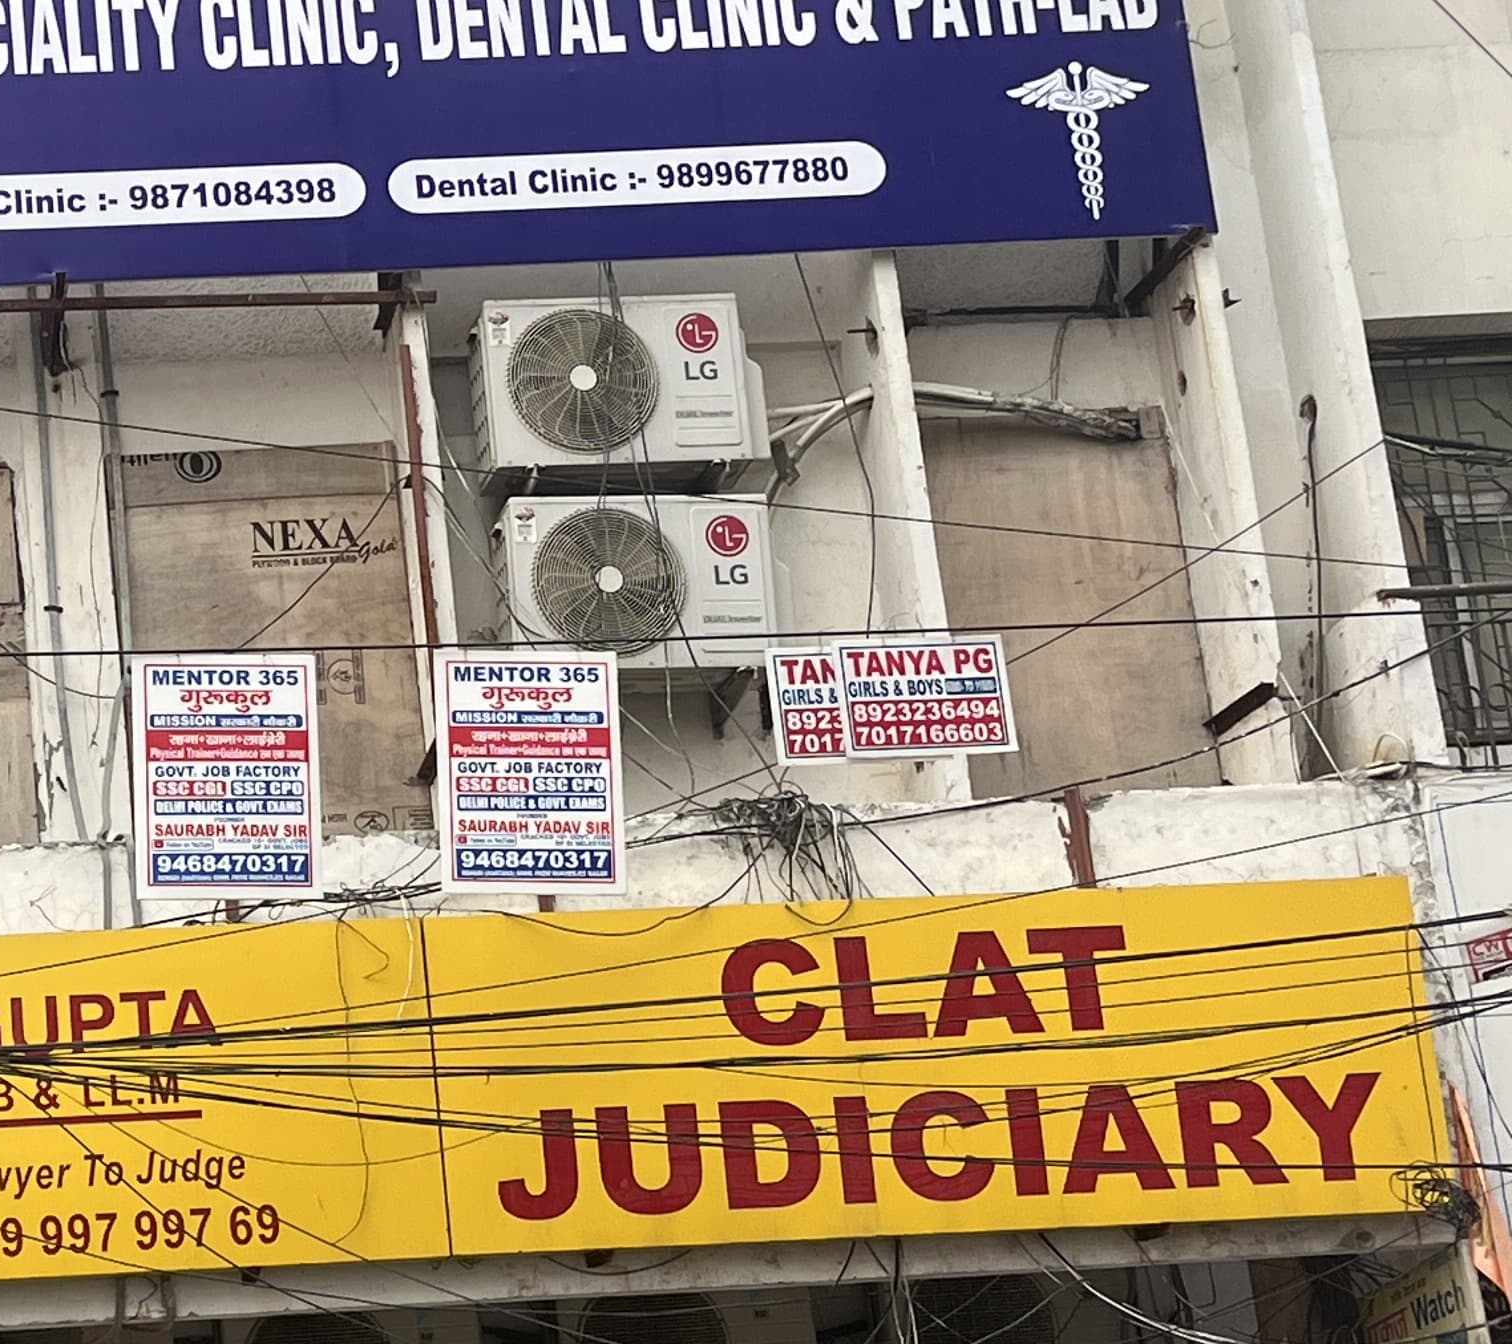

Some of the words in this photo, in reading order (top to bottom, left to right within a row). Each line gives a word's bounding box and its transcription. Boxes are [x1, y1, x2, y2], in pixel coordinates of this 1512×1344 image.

[415, 168, 520, 201] Dental
[526, 164, 619, 196] Clinic
[656, 154, 850, 190] 9899677880
[128, 176, 337, 212] 9871084398
[684, 360, 719, 381] LG
[250, 517, 360, 554] NEXA
[713, 564, 749, 586] LG
[847, 649, 946, 678] TANYA
[953, 647, 994, 674] PG
[152, 670, 251, 686] MENTOR
[259, 670, 299, 685] 365
[453, 666, 551, 682] MENTOR
[560, 667, 599, 682] 365
[848, 681, 889, 698] GIRLS
[908, 679, 943, 696] BOYS
[153, 716, 216, 726] MISSION
[455, 712, 518, 723] MISSION
[853, 699, 1001, 722] 8923236494
[856, 722, 1003, 745] 7017166603
[155, 766, 197, 777] GOVT.
[202, 766, 230, 777] JOB
[236, 766, 301, 777] FACTORY
[457, 762, 500, 774] GOVT.
[504, 762, 533, 774] JOB
[538, 762, 603, 774] FACTORY
[155, 825, 226, 837] SAURABH
[231, 824, 278, 837] YADAV
[284, 824, 307, 837] SIR
[458, 820, 529, 833] SAURABH
[535, 820, 581, 834] YADAV
[586, 820, 610, 834] SIR
[157, 855, 306, 873] 9468470317
[461, 851, 609, 868] 9468470317
[720, 924, 1126, 1048] CLAT
[82, 1072, 181, 1108] LL.M
[497, 1072, 1382, 1222] JUDICIARY
[84, 1154, 124, 1186] To
[137, 1150, 247, 1190] Judge
[40, 1212, 118, 1256] 997
[136, 1207, 213, 1251] 997
[229, 1204, 280, 1246] 69
[1410, 1280, 1467, 1330] Watch
